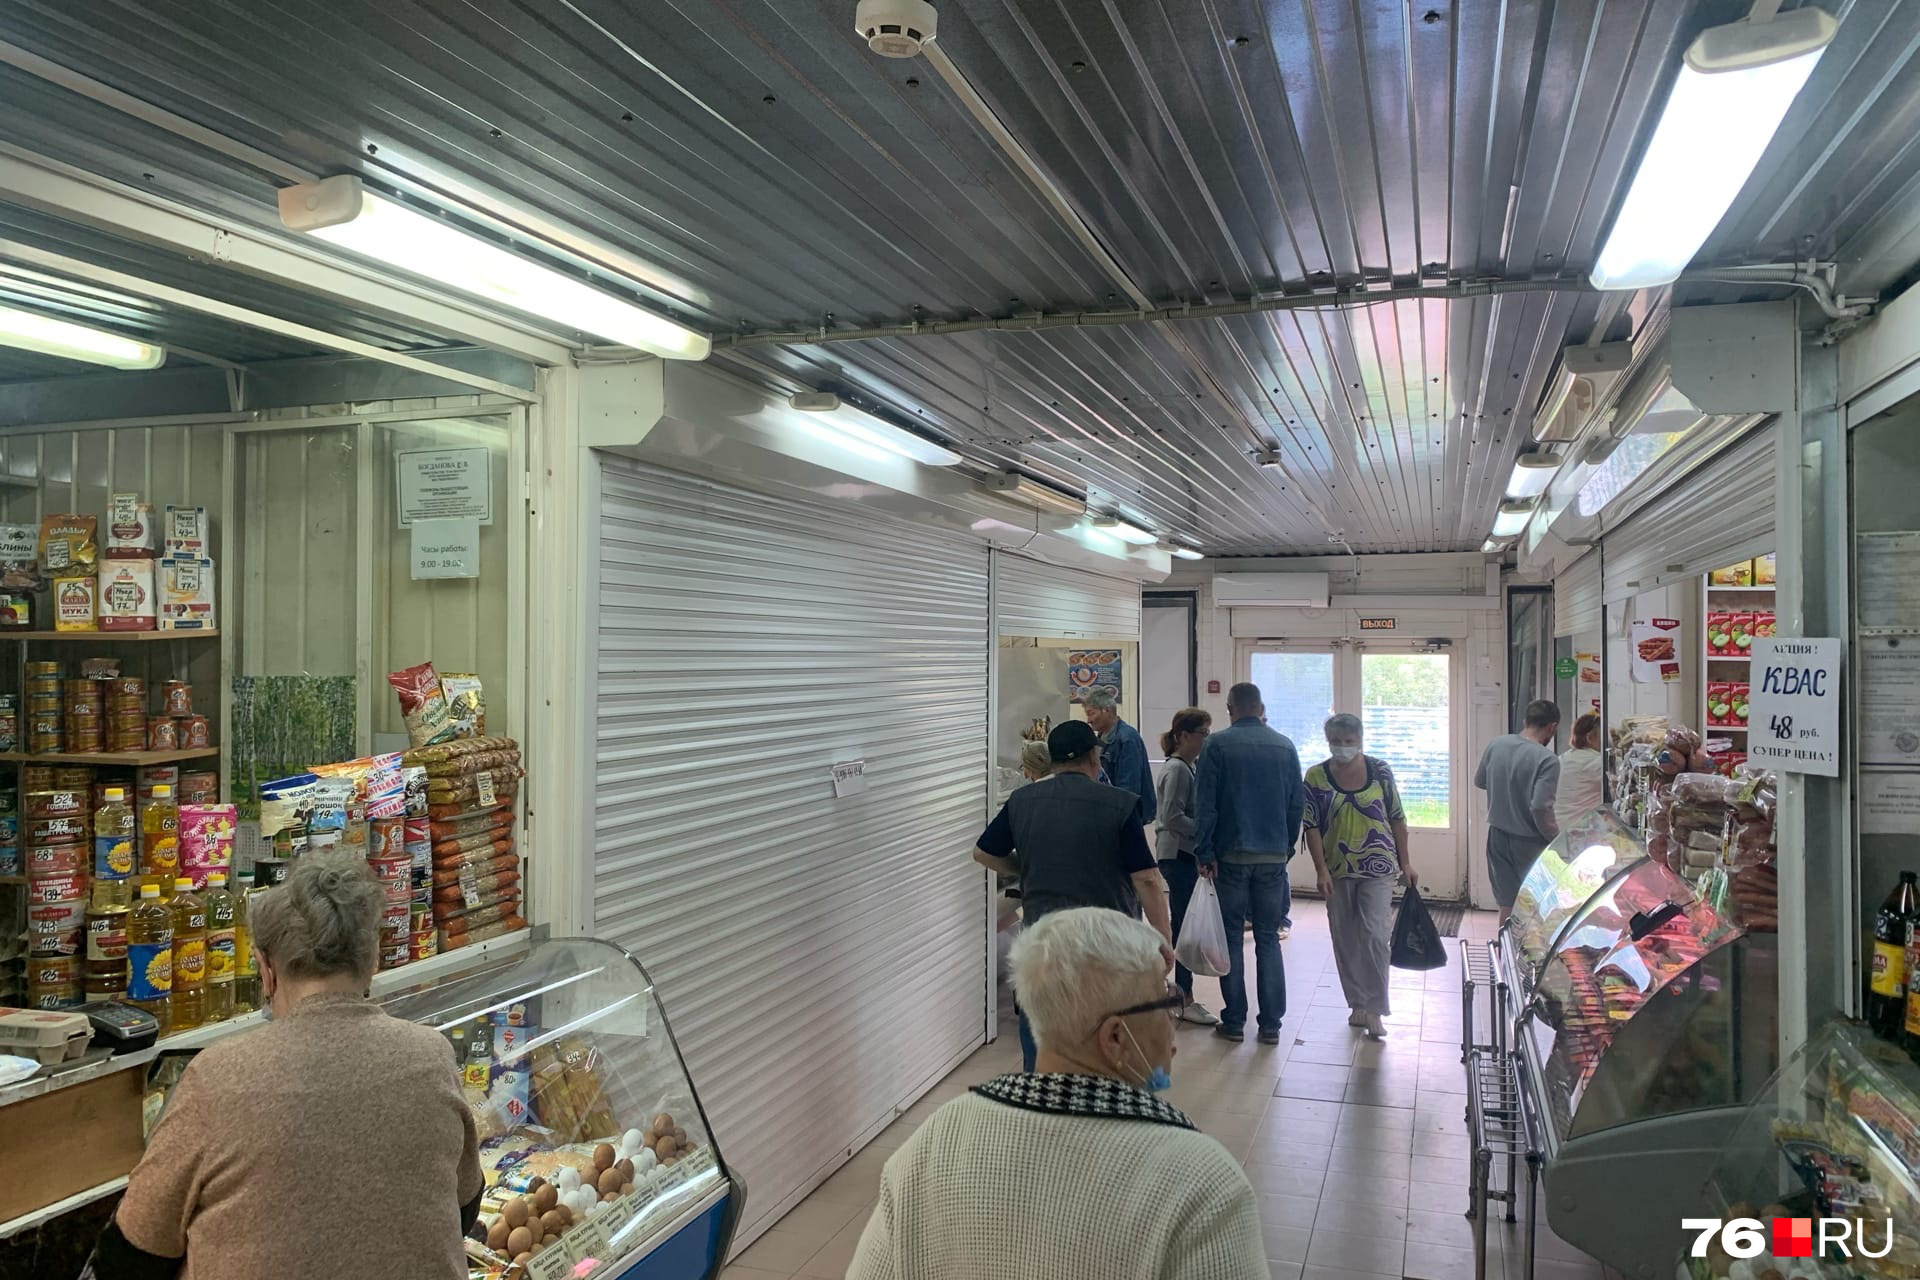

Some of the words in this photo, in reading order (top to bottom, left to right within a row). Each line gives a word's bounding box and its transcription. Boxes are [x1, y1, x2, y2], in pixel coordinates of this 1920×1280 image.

[61, 607, 90, 616] МУКА
[1362, 619, 1394, 629] ВЫХОД
[1762, 666, 1828, 697] КВАС
[1770, 714, 1794, 741] 48
[1799, 727, 1820, 738] руб.
[1753, 745, 1791, 758] СУПЕР
[1794, 750, 1825, 762] ЦЕНА
